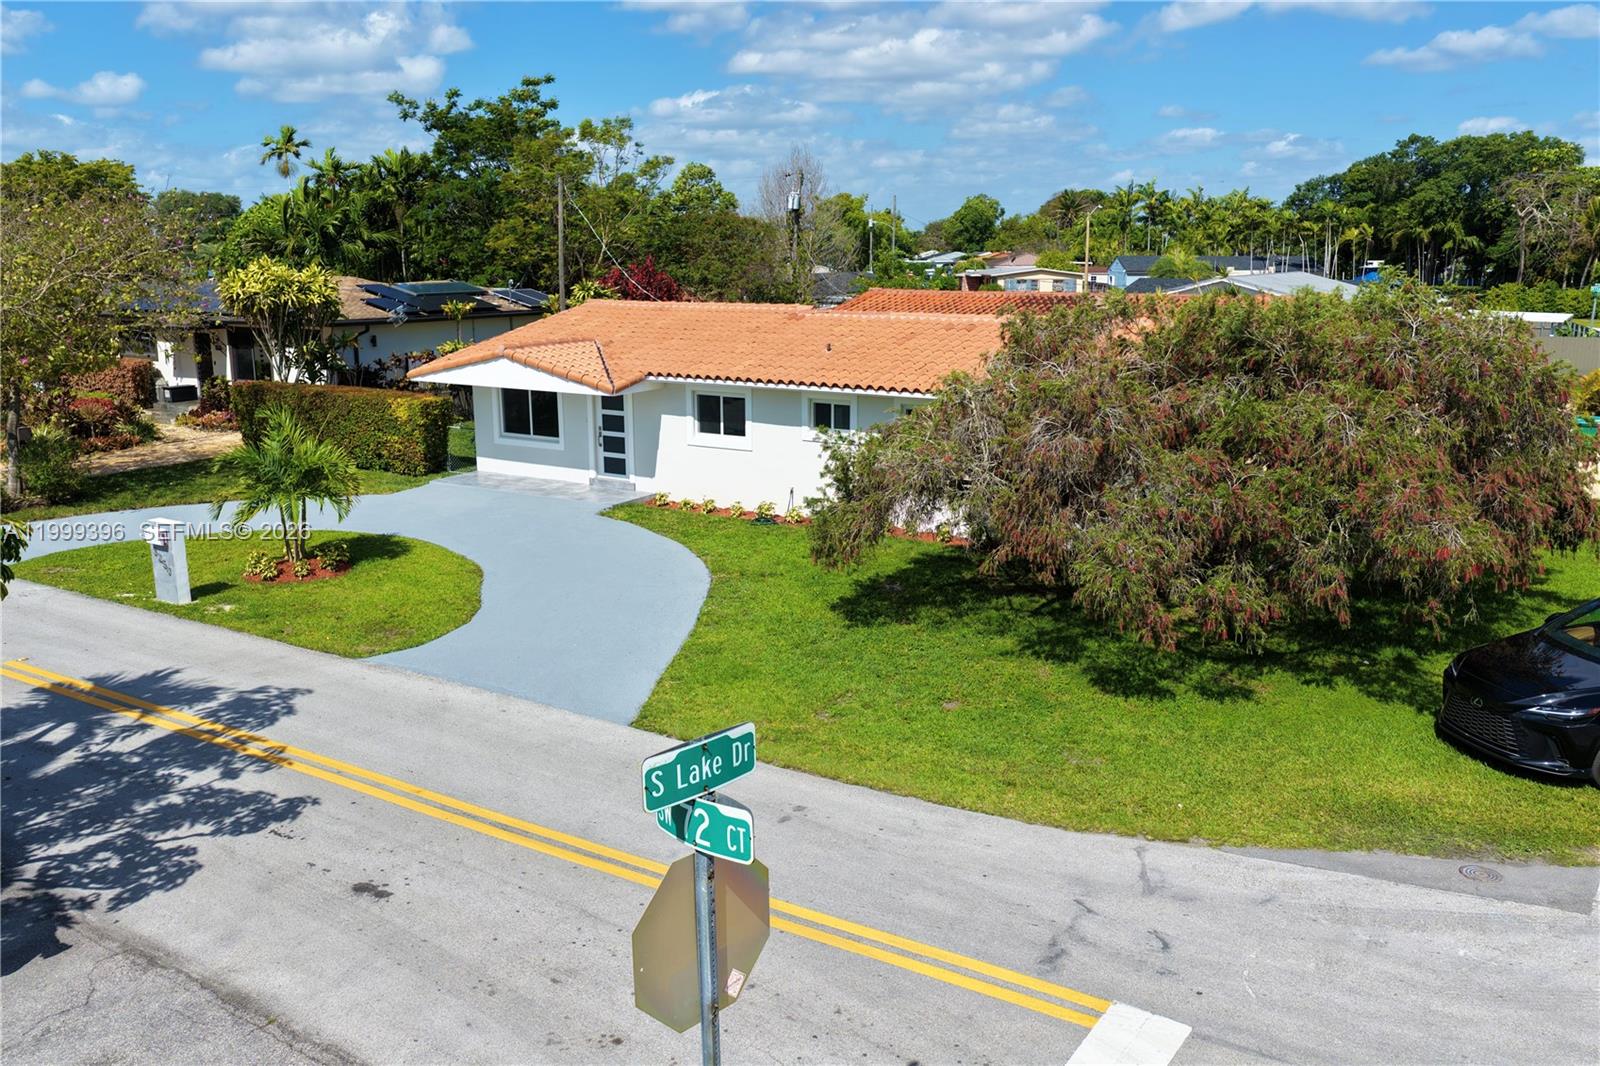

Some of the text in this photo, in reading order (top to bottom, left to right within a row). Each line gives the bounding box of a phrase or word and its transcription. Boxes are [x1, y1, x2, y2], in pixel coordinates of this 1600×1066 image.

[651, 741, 751, 797] S Lake Dr
[726, 825, 746, 853] CT
